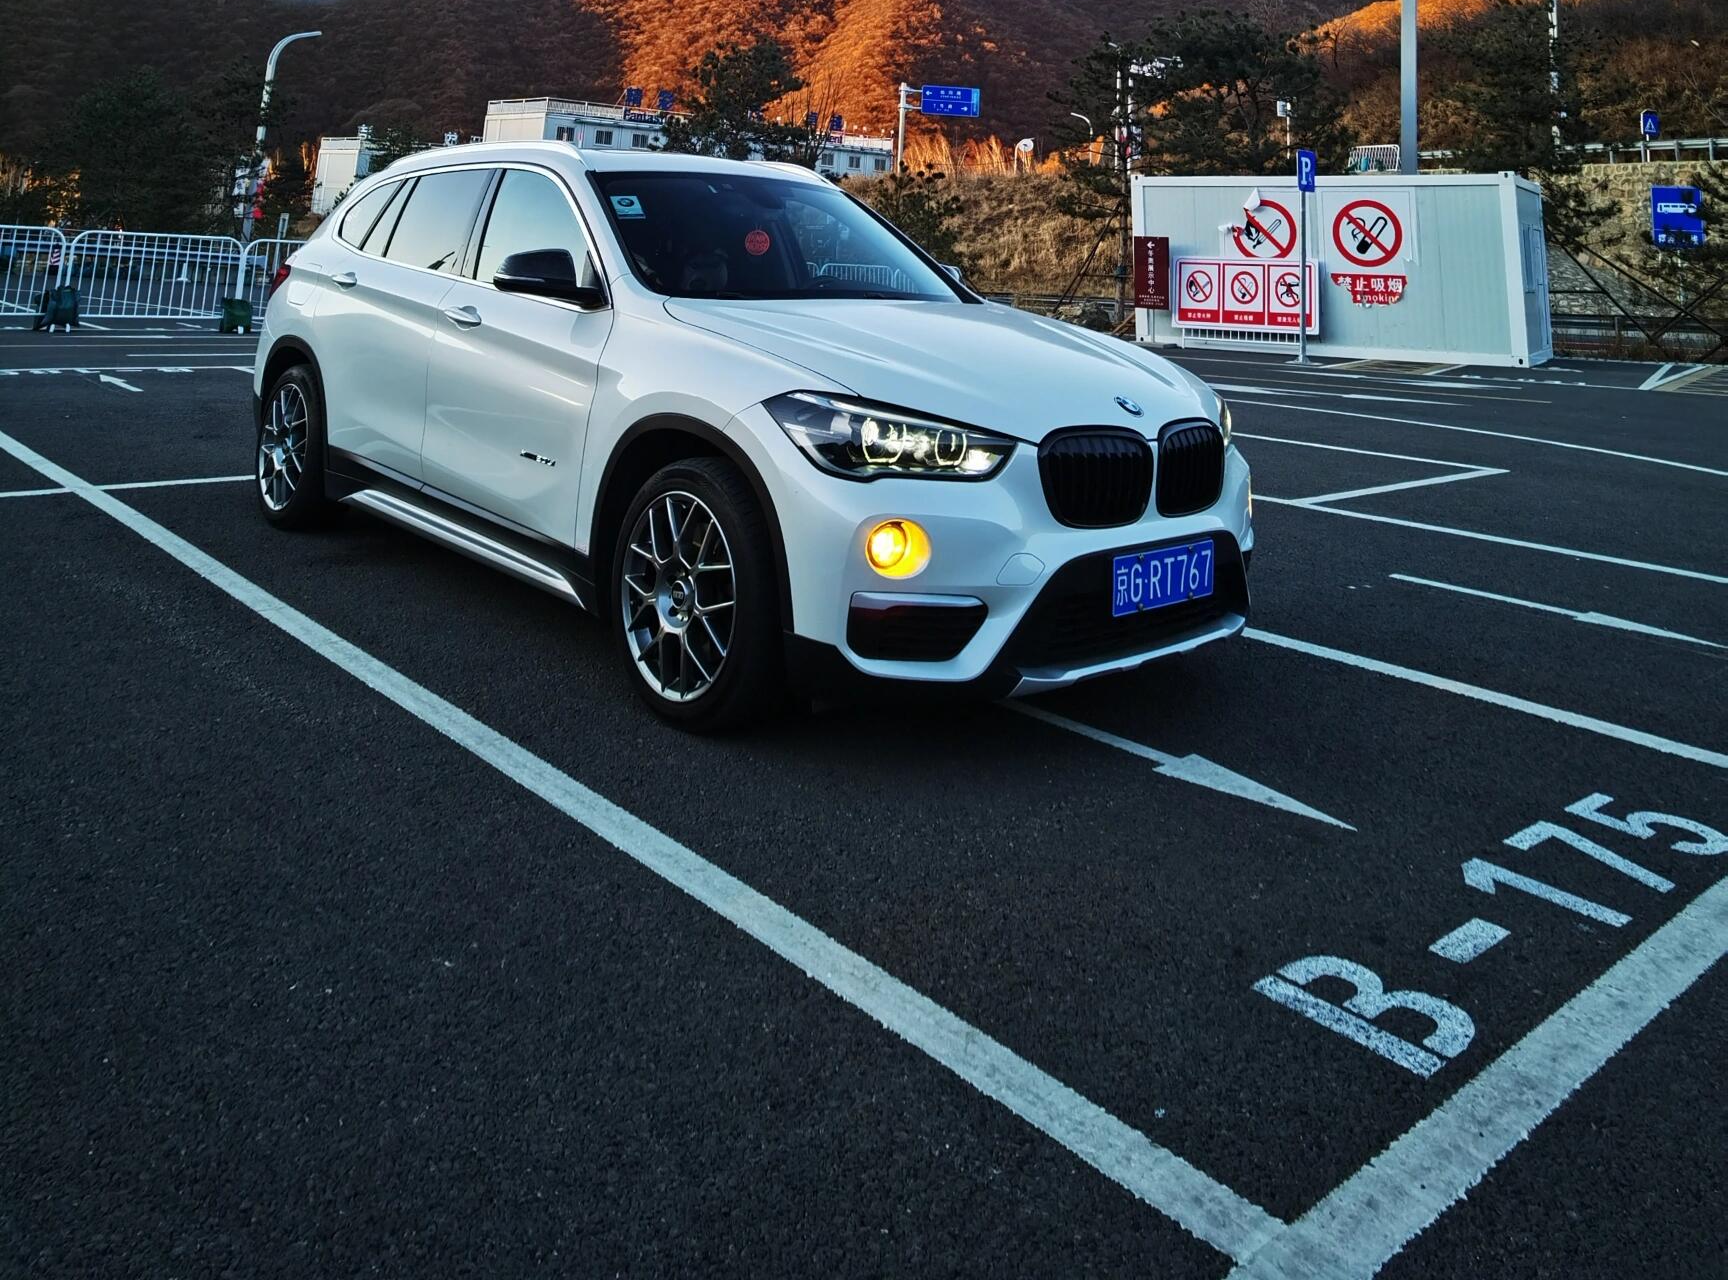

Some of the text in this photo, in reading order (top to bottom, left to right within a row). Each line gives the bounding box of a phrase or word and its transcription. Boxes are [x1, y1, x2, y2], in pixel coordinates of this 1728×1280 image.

[1301, 156, 1311, 185] P
[1337, 276, 1403, 293] 禁止吸烟
[1251, 792, 1728, 1080] B-175
